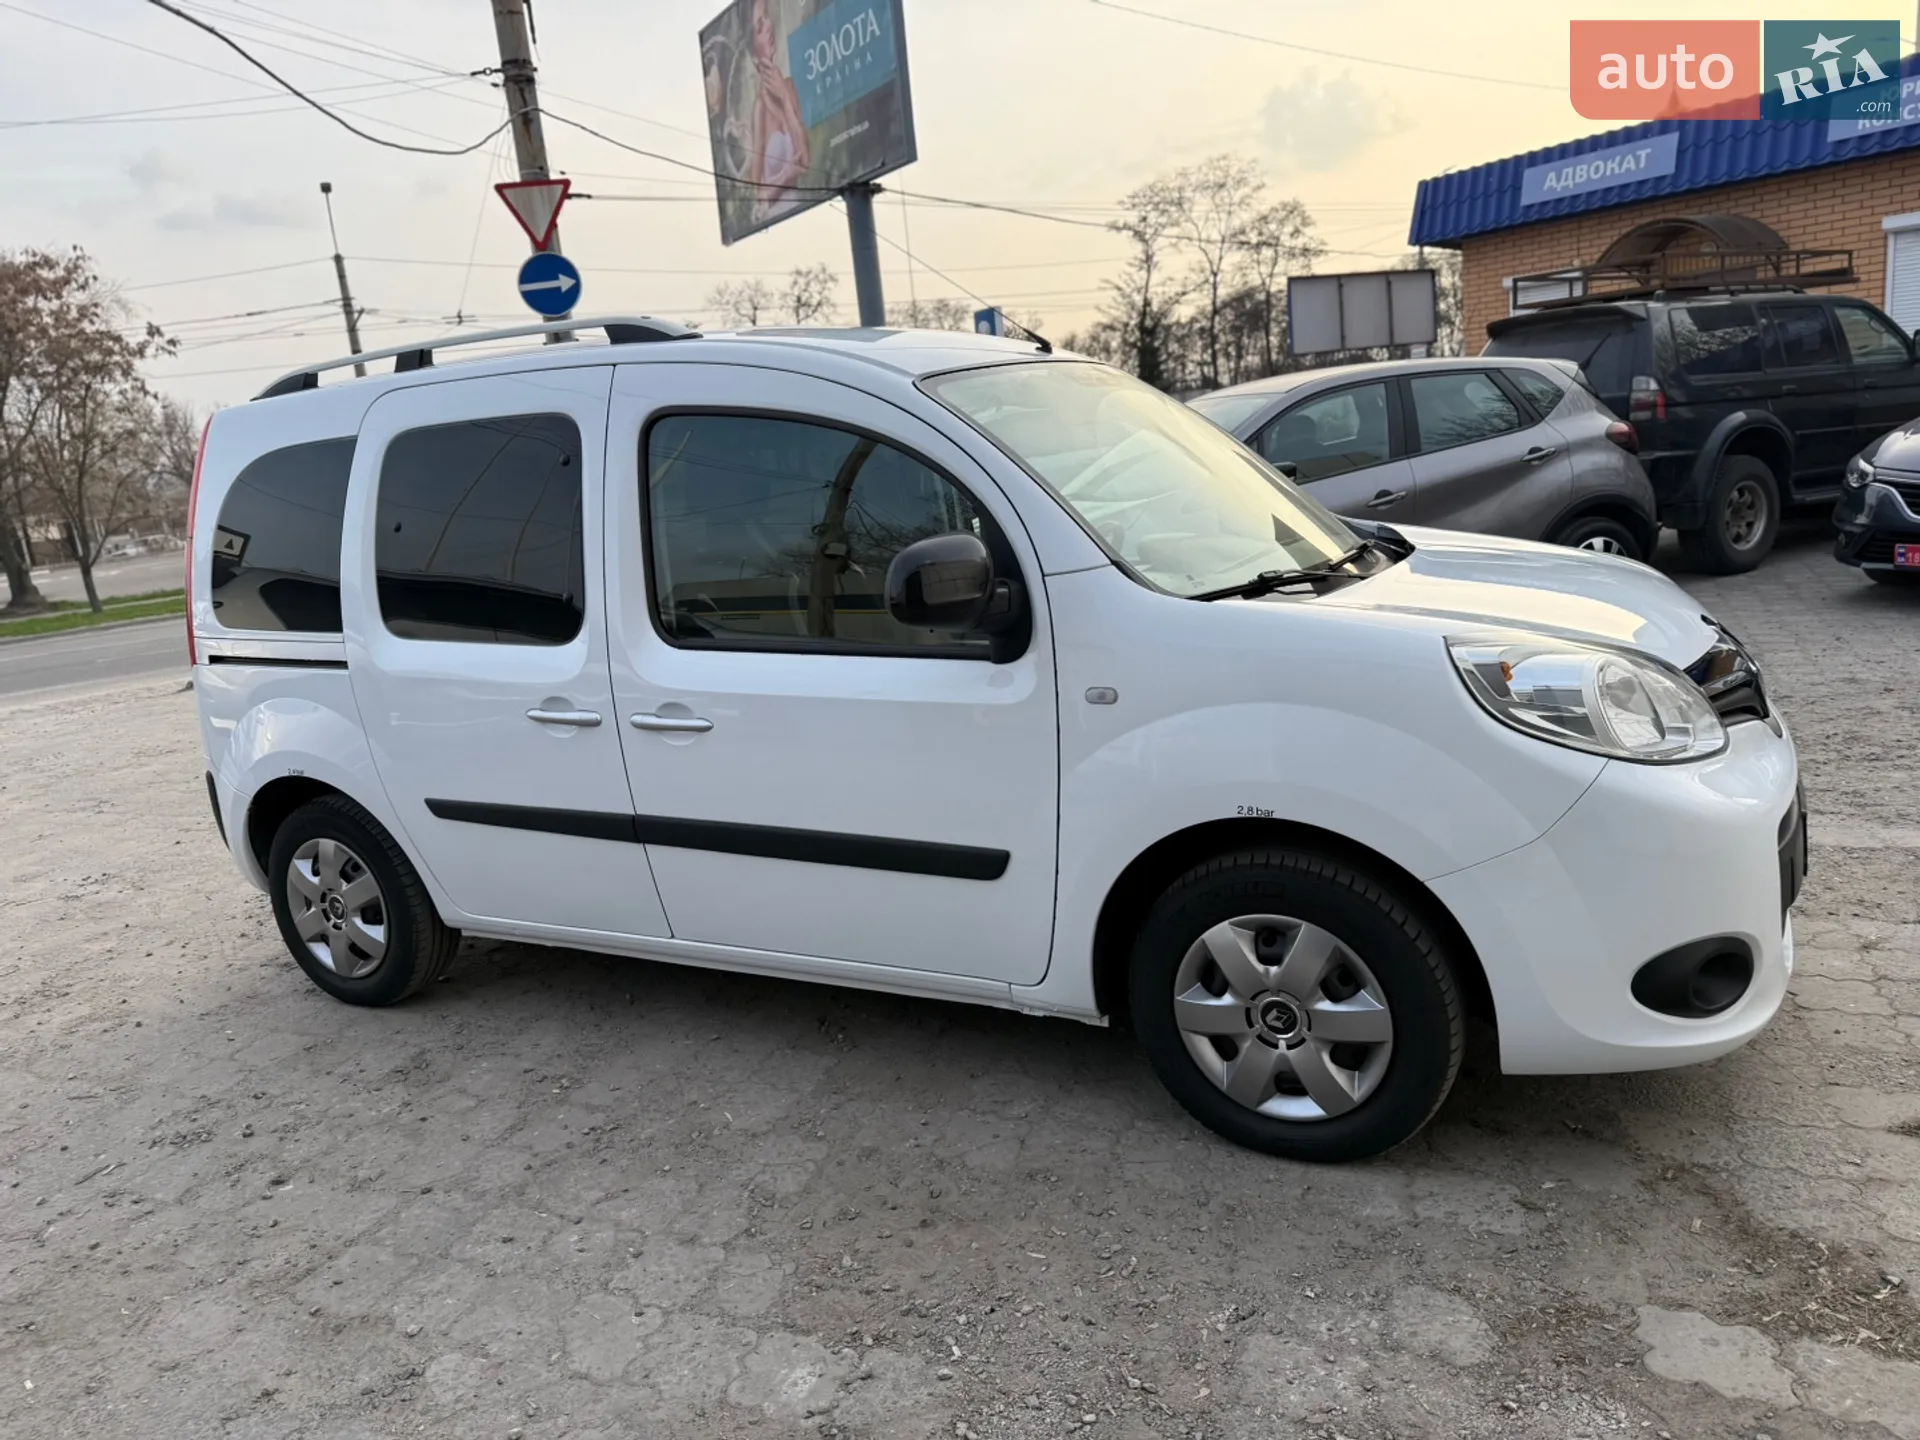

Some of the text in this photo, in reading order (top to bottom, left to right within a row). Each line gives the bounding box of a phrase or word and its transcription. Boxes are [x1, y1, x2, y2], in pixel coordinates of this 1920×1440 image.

[804, 7, 880, 80] ЗОЛОТА
[1543, 148, 1652, 192] АДВОКАТ
[1237, 805, 1275, 817] 2,8 bar
